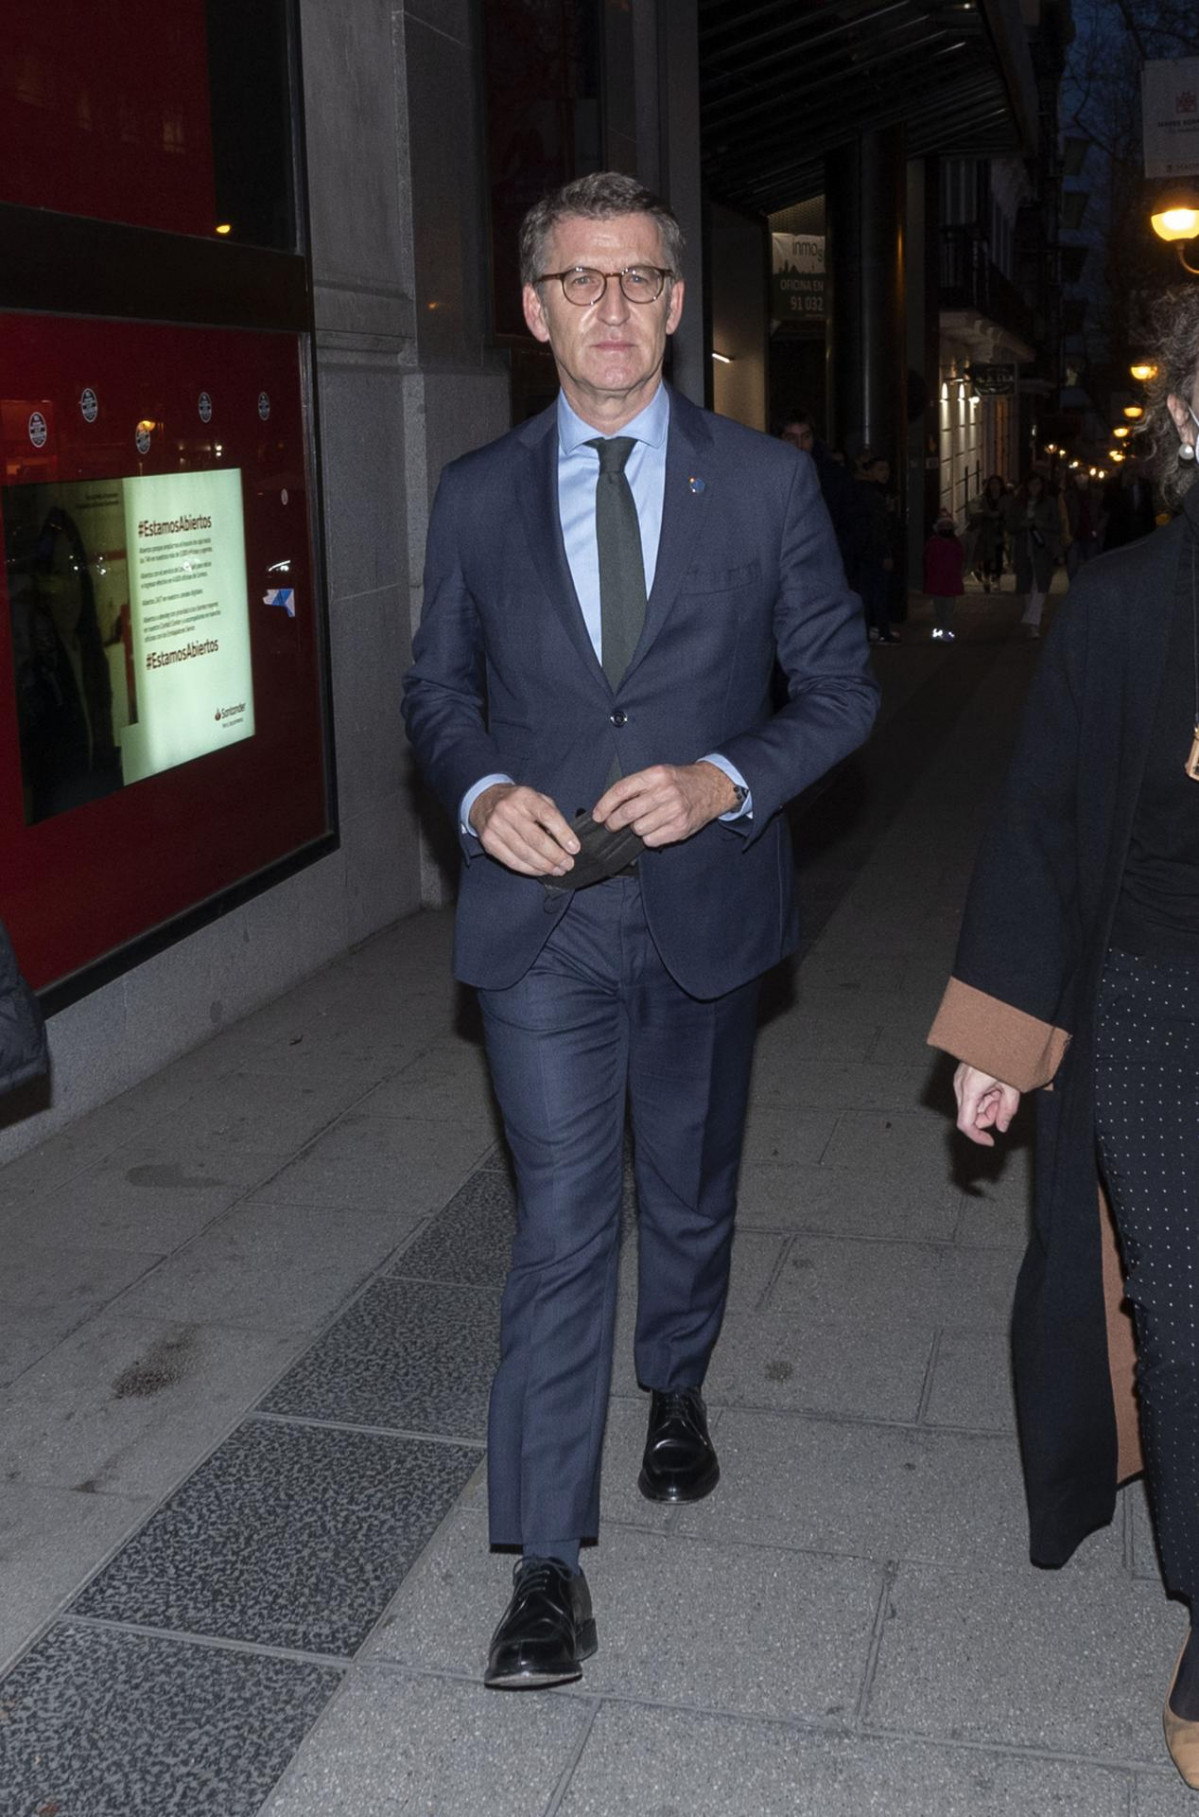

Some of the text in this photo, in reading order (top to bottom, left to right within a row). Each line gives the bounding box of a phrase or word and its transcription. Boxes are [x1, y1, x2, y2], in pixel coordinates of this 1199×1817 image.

[790, 296, 823, 311] 91 032
[138, 514, 212, 537] #EstamosAbiertos
[146, 639, 219, 670] #EstamosAbiertos
[221, 703, 246, 719] Santander
